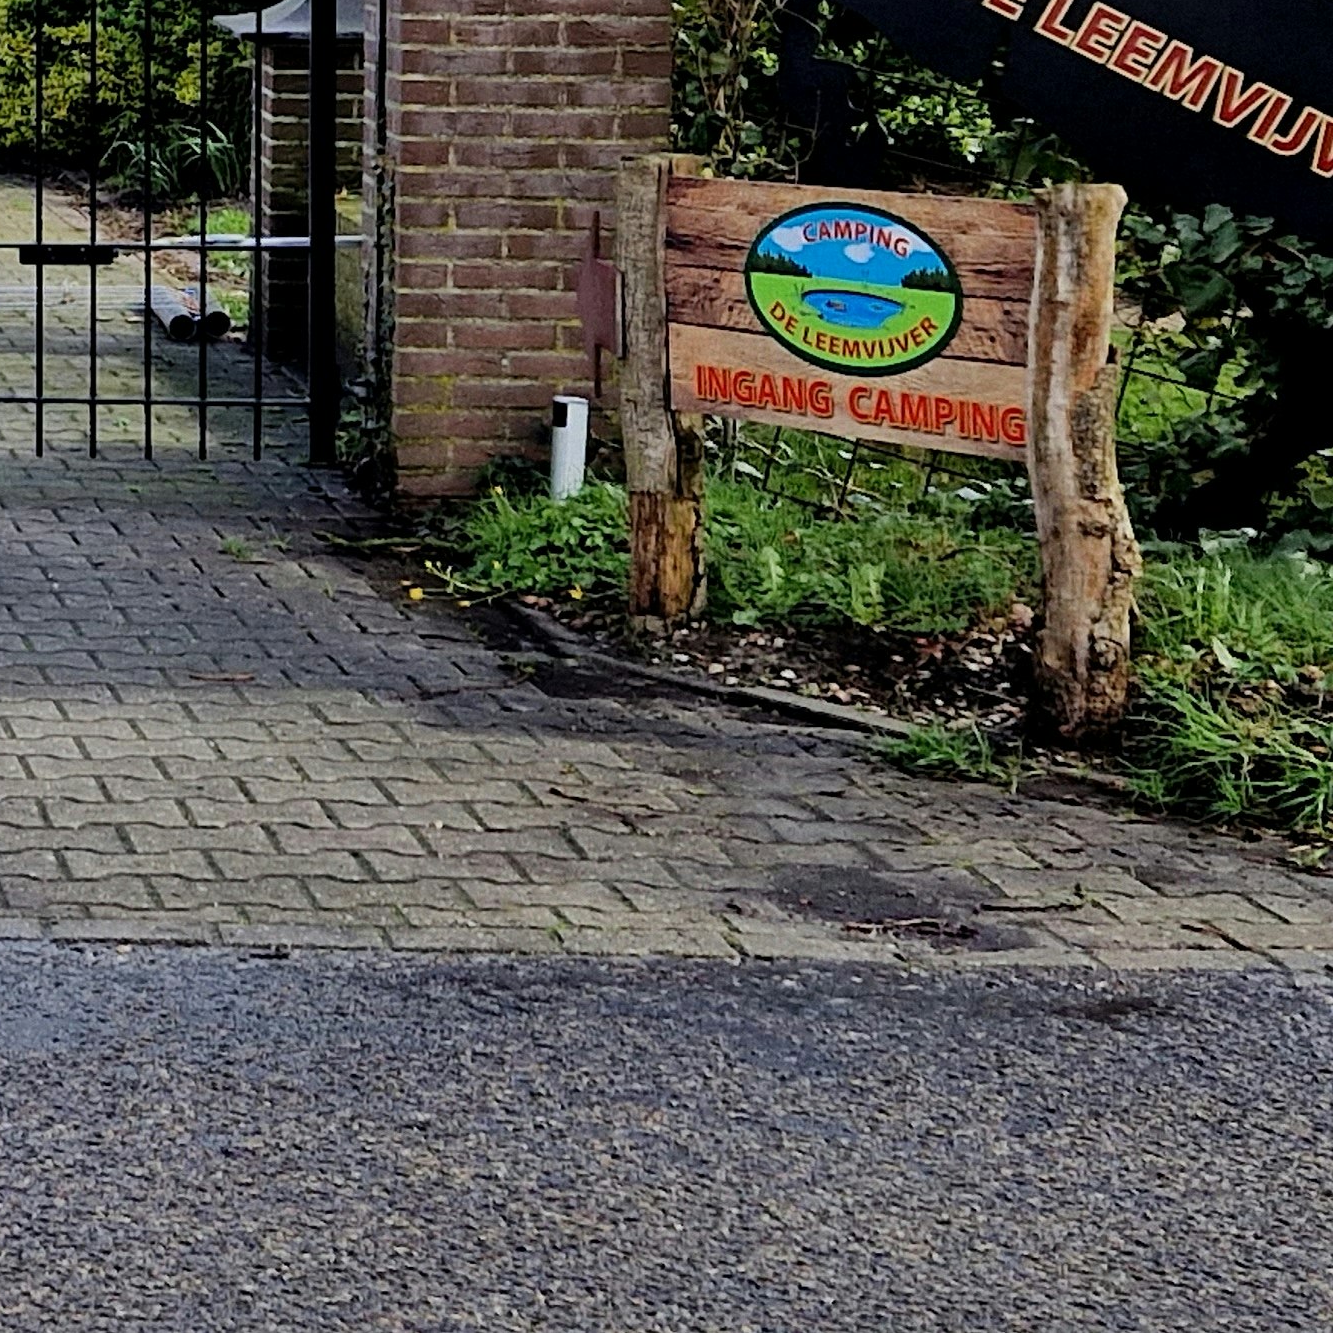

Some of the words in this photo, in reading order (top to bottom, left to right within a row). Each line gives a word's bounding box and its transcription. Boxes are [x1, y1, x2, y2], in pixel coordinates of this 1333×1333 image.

[803, 220, 911, 257] CAMPING
[769, 300, 796, 335] DE
[802, 316, 938, 359] LEEMVIJVER
[694, 365, 834, 417] INGANG
[848, 386, 1027, 446] CAMPING
